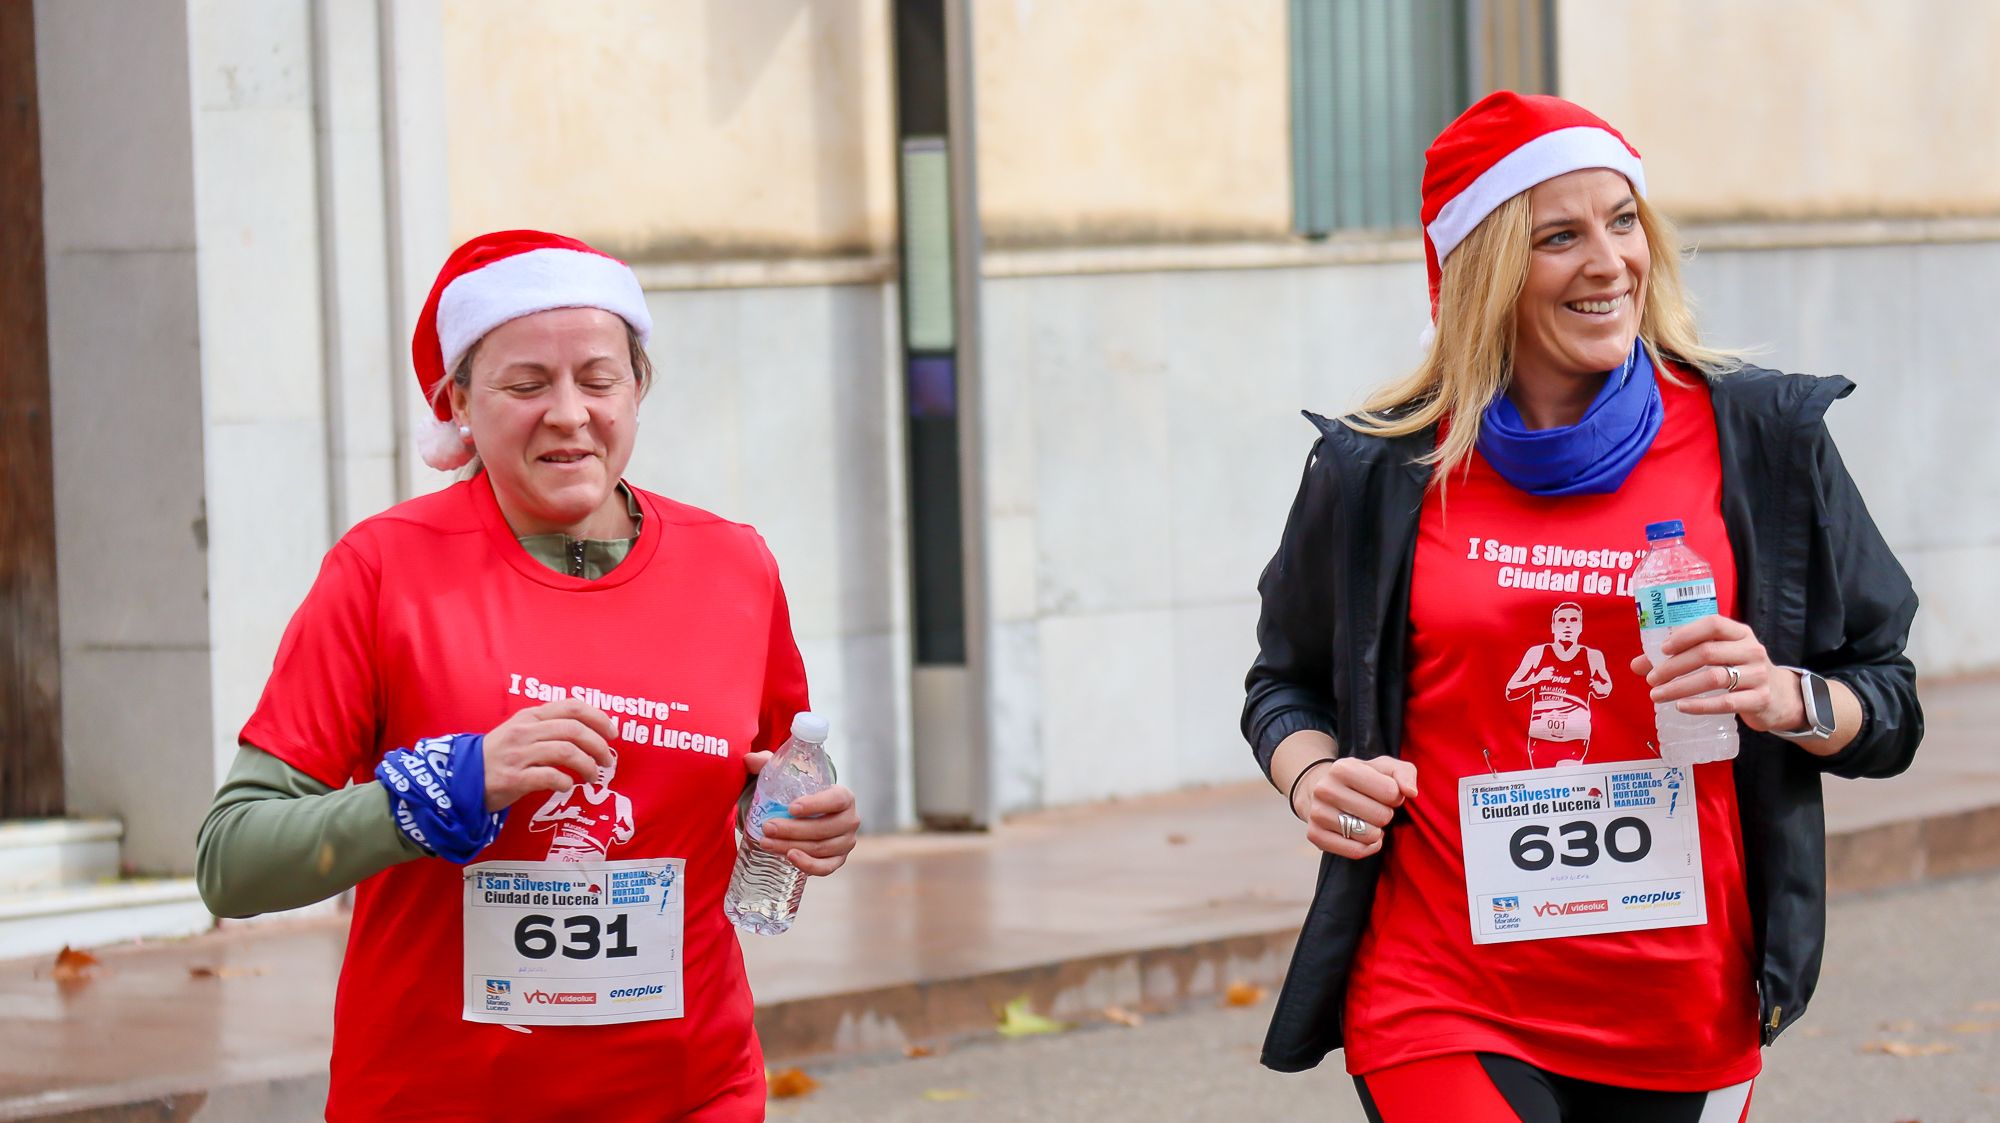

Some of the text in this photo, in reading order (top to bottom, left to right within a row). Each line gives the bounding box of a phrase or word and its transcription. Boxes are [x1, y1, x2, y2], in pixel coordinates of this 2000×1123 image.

[1468, 538, 1480, 559] I
[1484, 539, 1528, 564] San
[1531, 544, 1634, 570] Silvestre
[1498, 566, 1580, 592] Ciudad
[1583, 572, 1612, 596] de
[508, 673, 522, 695] I
[524, 677, 566, 702] San
[570, 686, 669, 721] Silvestre
[1548, 720, 1565, 730] 001
[622, 720, 650, 744] de
[653, 724, 729, 758] Lucena
[1612, 772, 1652, 782] MEMORIAL
[1632, 780, 1662, 788] CARLOS
[1472, 794, 1479, 806] I
[1482, 793, 1507, 805] San
[1510, 787, 1570, 803] Silvestre
[1613, 789, 1649, 799] HURTADO
[1614, 797, 1656, 808] MARJALIZO
[1482, 800, 1601, 819] Ciudad de Lucena
[1509, 816, 1652, 871] 630
[612, 871, 648, 880] MEMORIAL
[477, 877, 482, 889] I
[486, 878, 510, 890] San
[514, 879, 570, 892] Silvestre
[613, 878, 656, 888] JOSE CARLOS
[485, 891, 598, 905] Ciudad de Lucena
[612, 888, 645, 896] HURTADO
[1622, 891, 1681, 904] enerplus
[612, 895, 650, 904] MARJALIZO
[1570, 902, 1605, 912] videoluc
[514, 914, 637, 959] 631
[610, 985, 663, 998] enerplus
